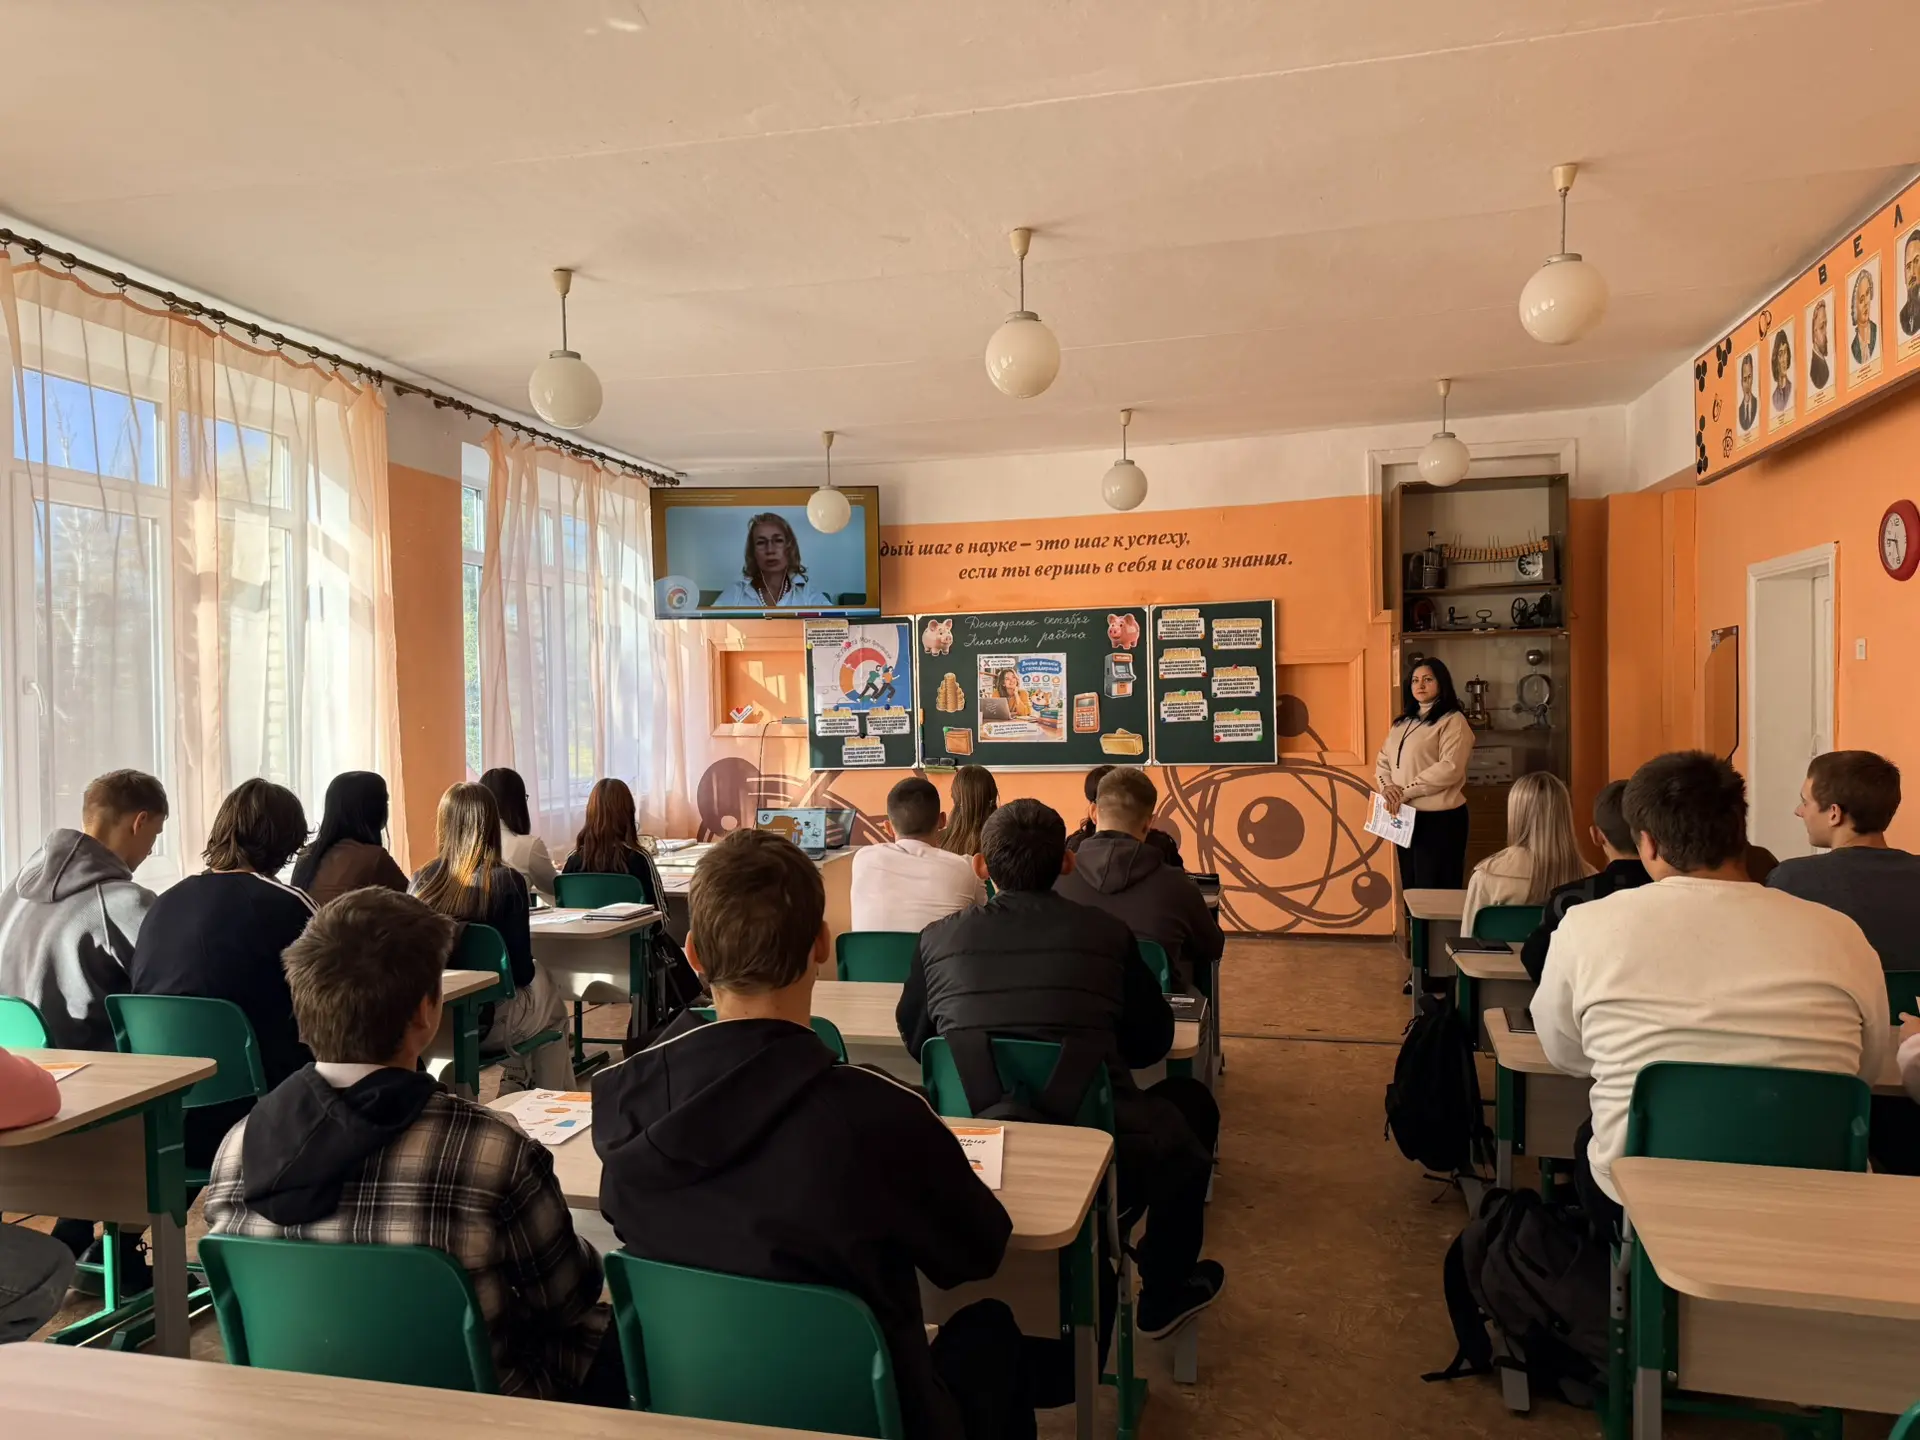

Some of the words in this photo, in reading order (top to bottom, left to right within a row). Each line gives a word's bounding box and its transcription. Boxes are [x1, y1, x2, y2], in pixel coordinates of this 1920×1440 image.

[918, 543, 953, 556] шаг
[955, 542, 964, 554] в
[967, 540, 1018, 557] науке
[1035, 537, 1070, 551] это
[1074, 536, 1110, 549] шаг
[1112, 535, 1124, 548] к
[1124, 531, 1191, 550] успеху,
[958, 566, 998, 580] если
[1001, 565, 1031, 578] ты
[1034, 562, 1101, 581] веришь
[1104, 563, 1114, 574] в
[1117, 555, 1157, 573] себя
[1161, 559, 1173, 571] и
[1176, 556, 1219, 570] свои
[1222, 552, 1294, 569] знания.
[1043, 612, 1091, 631] октября
[963, 632, 1030, 648] Классная
[1036, 628, 1087, 649] работа
